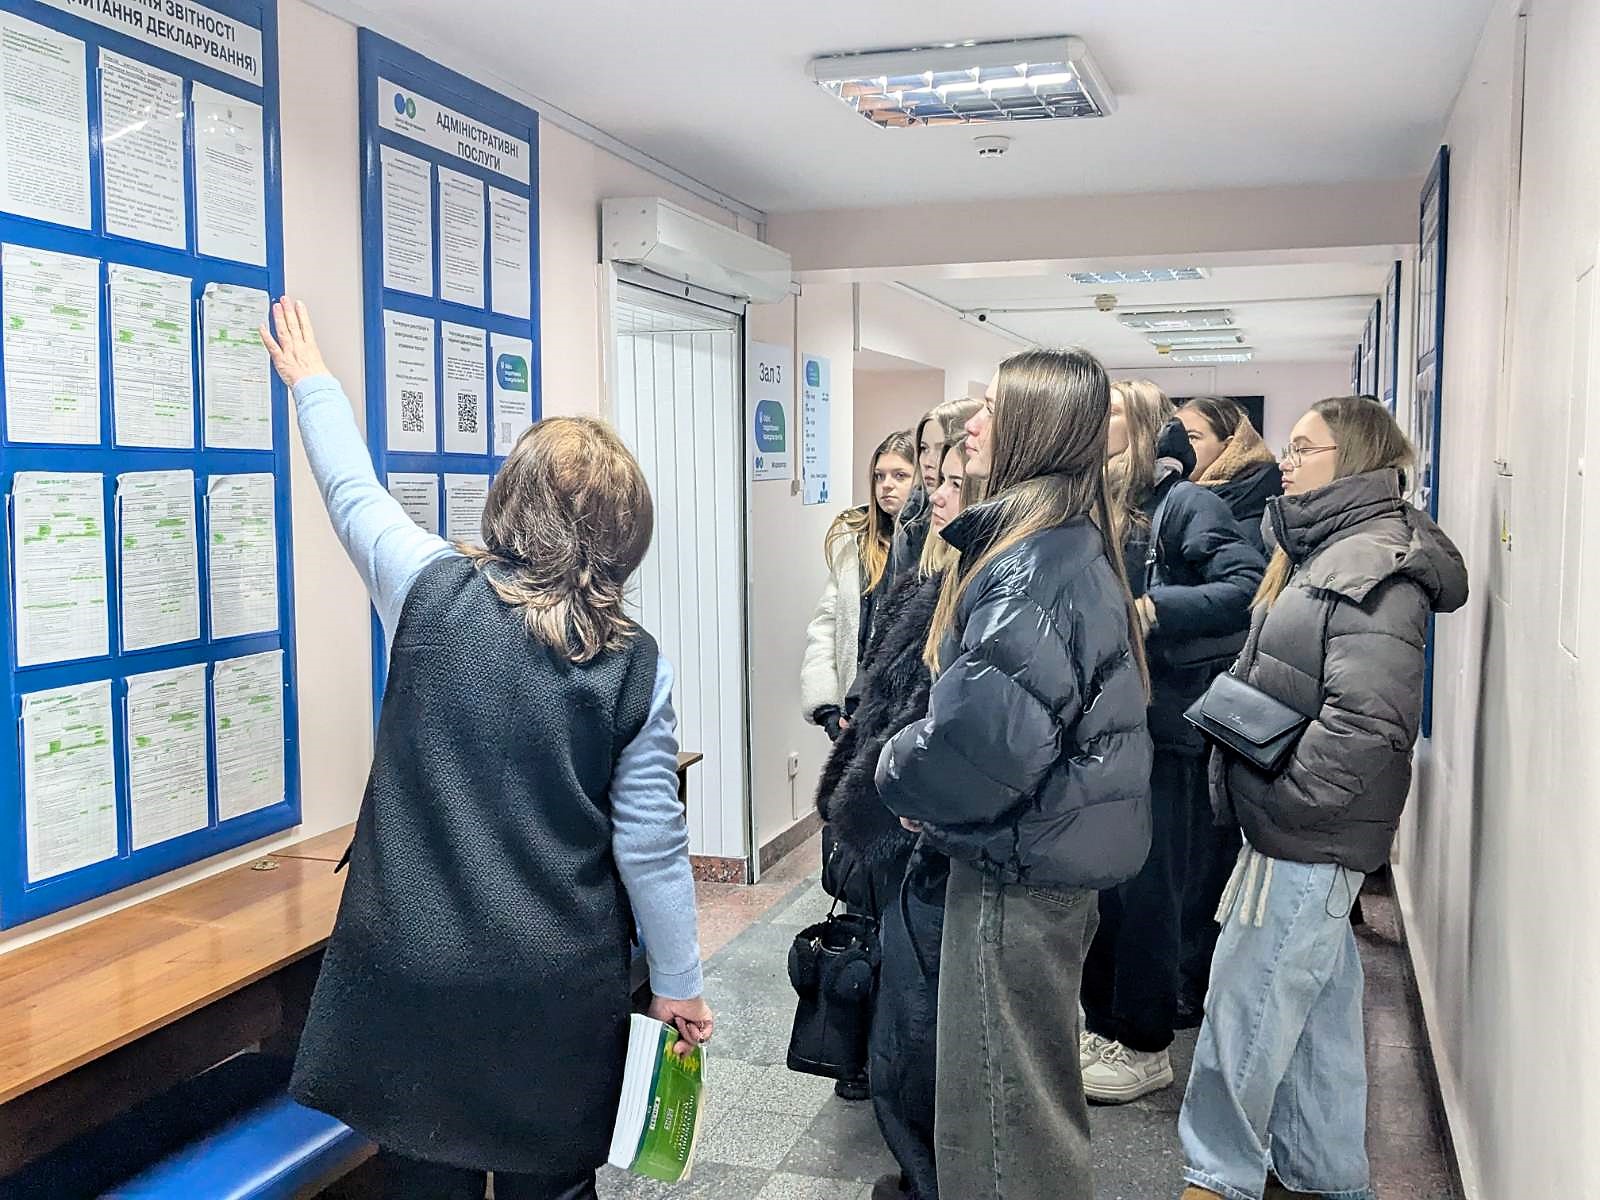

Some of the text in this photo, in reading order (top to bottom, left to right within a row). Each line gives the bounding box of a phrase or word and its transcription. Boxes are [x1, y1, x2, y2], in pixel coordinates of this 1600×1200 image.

[66, 0, 257, 76] ИТАННЯ ДЕКЛАРУВАННЯ)
[166, 3, 235, 42] ЗВІТНОСТІ
[436, 111, 519, 158] АДМІНІСТРАТИВНІ
[457, 141, 501, 170] ПОСЛУГИ
[759, 361, 781, 384] Зал 3
